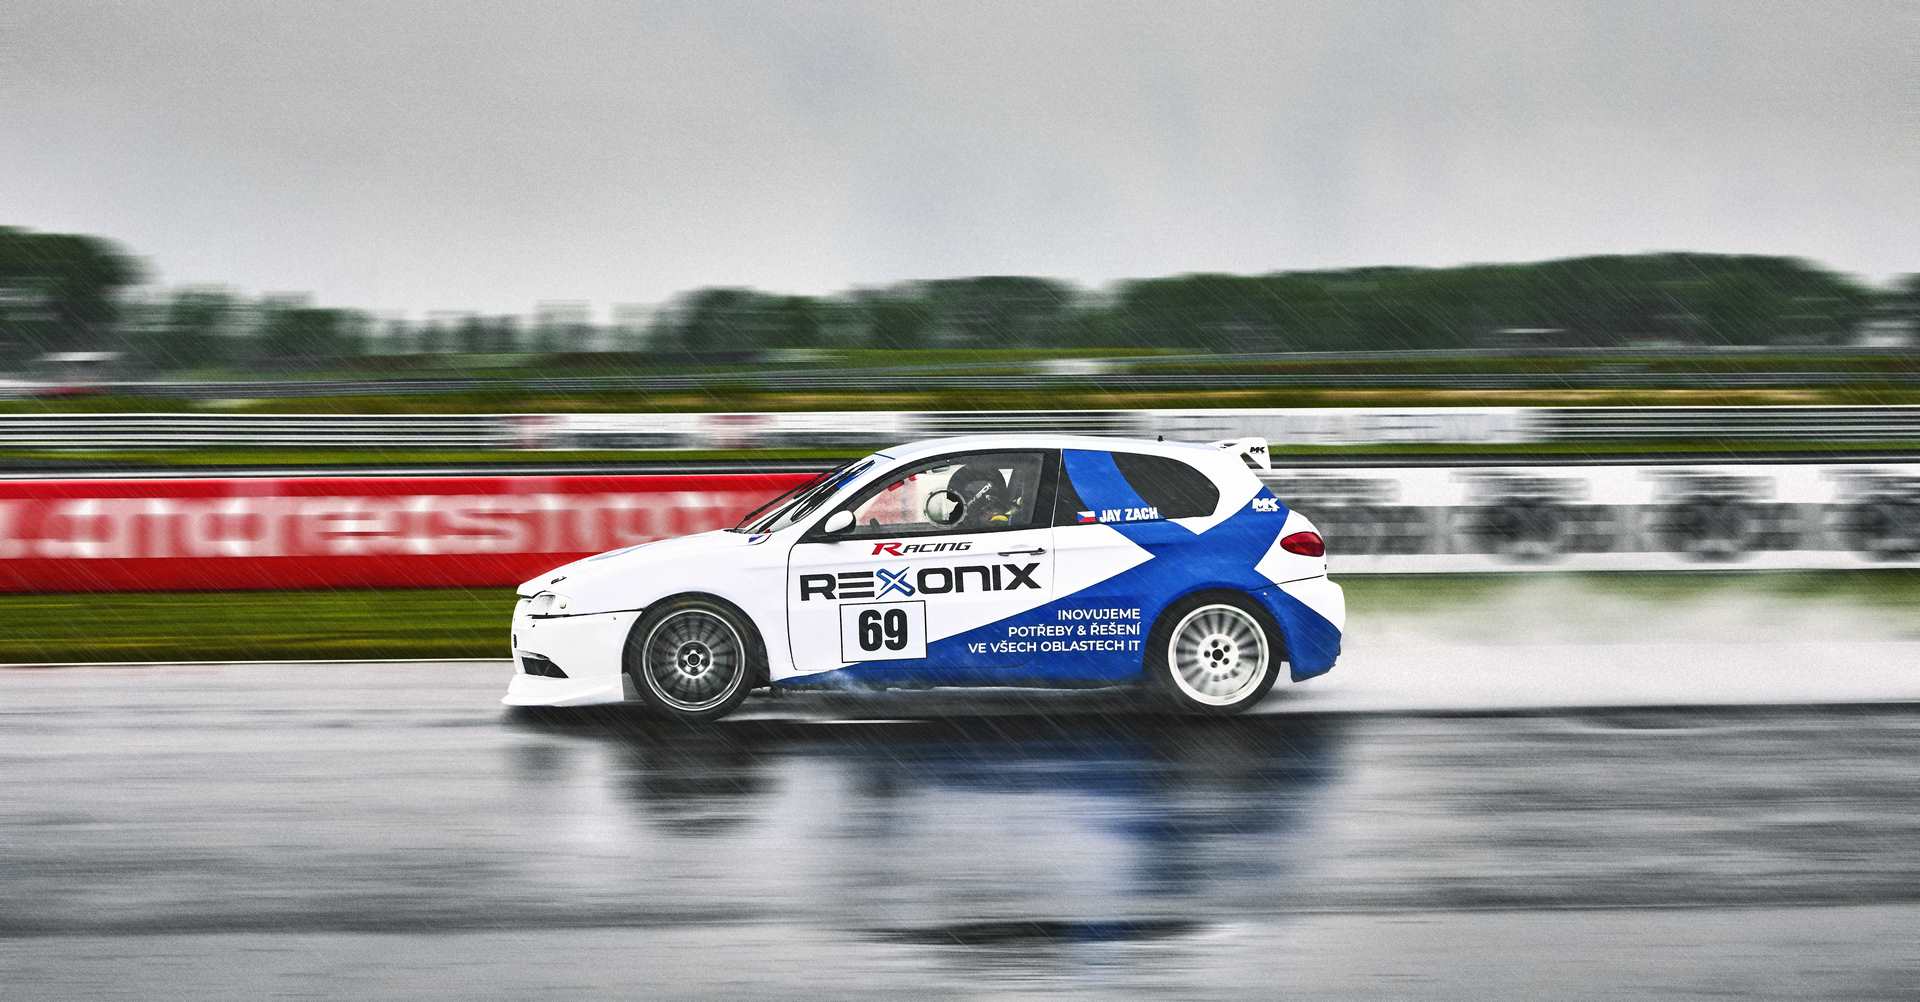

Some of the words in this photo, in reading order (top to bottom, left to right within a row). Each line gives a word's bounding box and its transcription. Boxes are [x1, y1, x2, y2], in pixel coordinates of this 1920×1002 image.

[1250, 446, 1265, 455] MK
[1252, 498, 1280, 509] MK
[1100, 509, 1121, 523] JAY
[1125, 507, 1158, 521] ZACH
[871, 542, 973, 556] RACING
[800, 562, 1042, 601] REXONIX
[1058, 608, 1141, 621] INOVUJEME
[858, 608, 908, 651] 69
[1008, 624, 1075, 637] POTŘEBY
[1077, 625, 1087, 636] &
[1090, 621, 1141, 636] ŘEŠENÍ
[968, 643, 986, 653] VE
[990, 640, 1037, 653] VŠECH
[1040, 640, 1125, 652] OBLASTECH
[1128, 640, 1141, 651] IT
